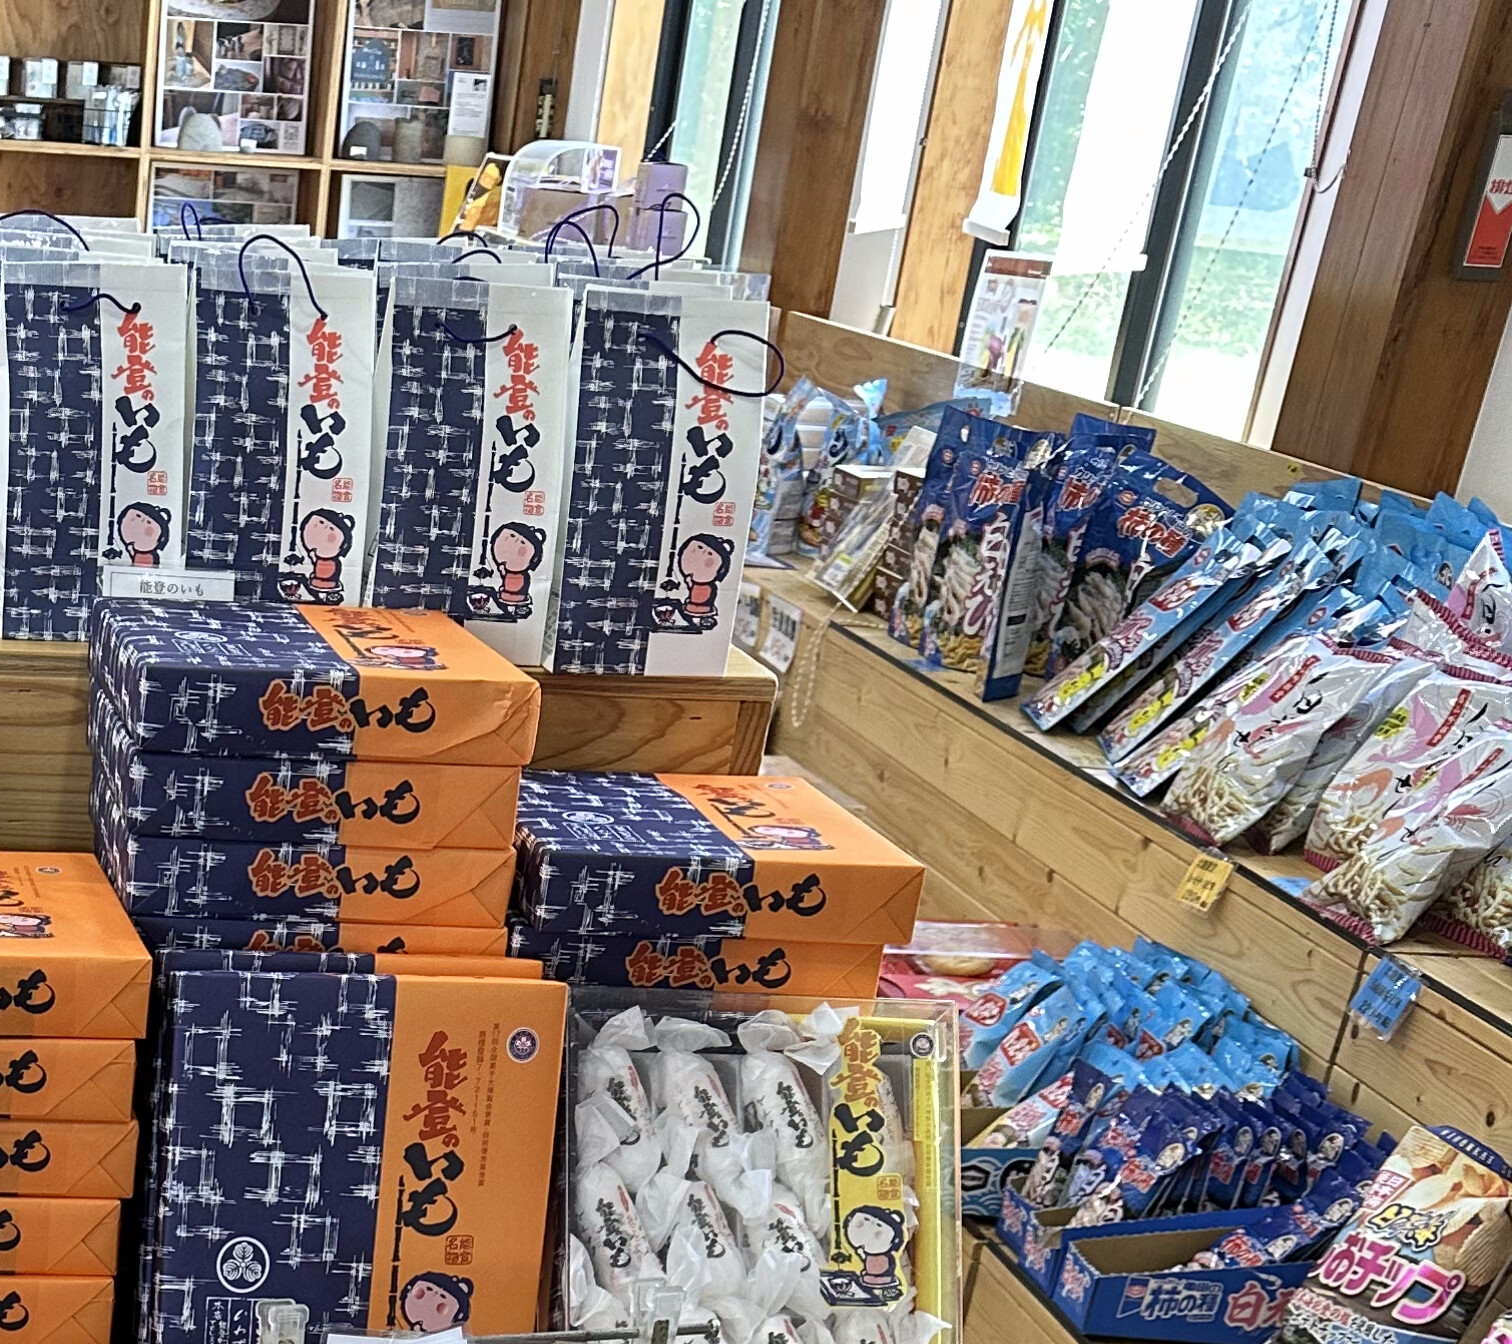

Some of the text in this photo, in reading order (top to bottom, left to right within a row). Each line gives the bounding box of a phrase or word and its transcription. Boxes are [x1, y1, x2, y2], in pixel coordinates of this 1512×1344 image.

[110, 312, 161, 474] 能登のいも
[297, 318, 347, 481] 能登のいも
[491, 330, 541, 493] 能登のいも
[683, 341, 734, 505] 能登のいも
[139, 579, 205, 598] 能登のいも
[259, 677, 437, 734] 能登のいも
[245, 771, 421, 825] 能登のいも
[247, 847, 421, 899] 能登のいも
[402, 1030, 469, 1237] 能登のいも
[829, 1018, 887, 1177] 能登のいも
[1141, 1284, 1220, 1320] 柿の種
